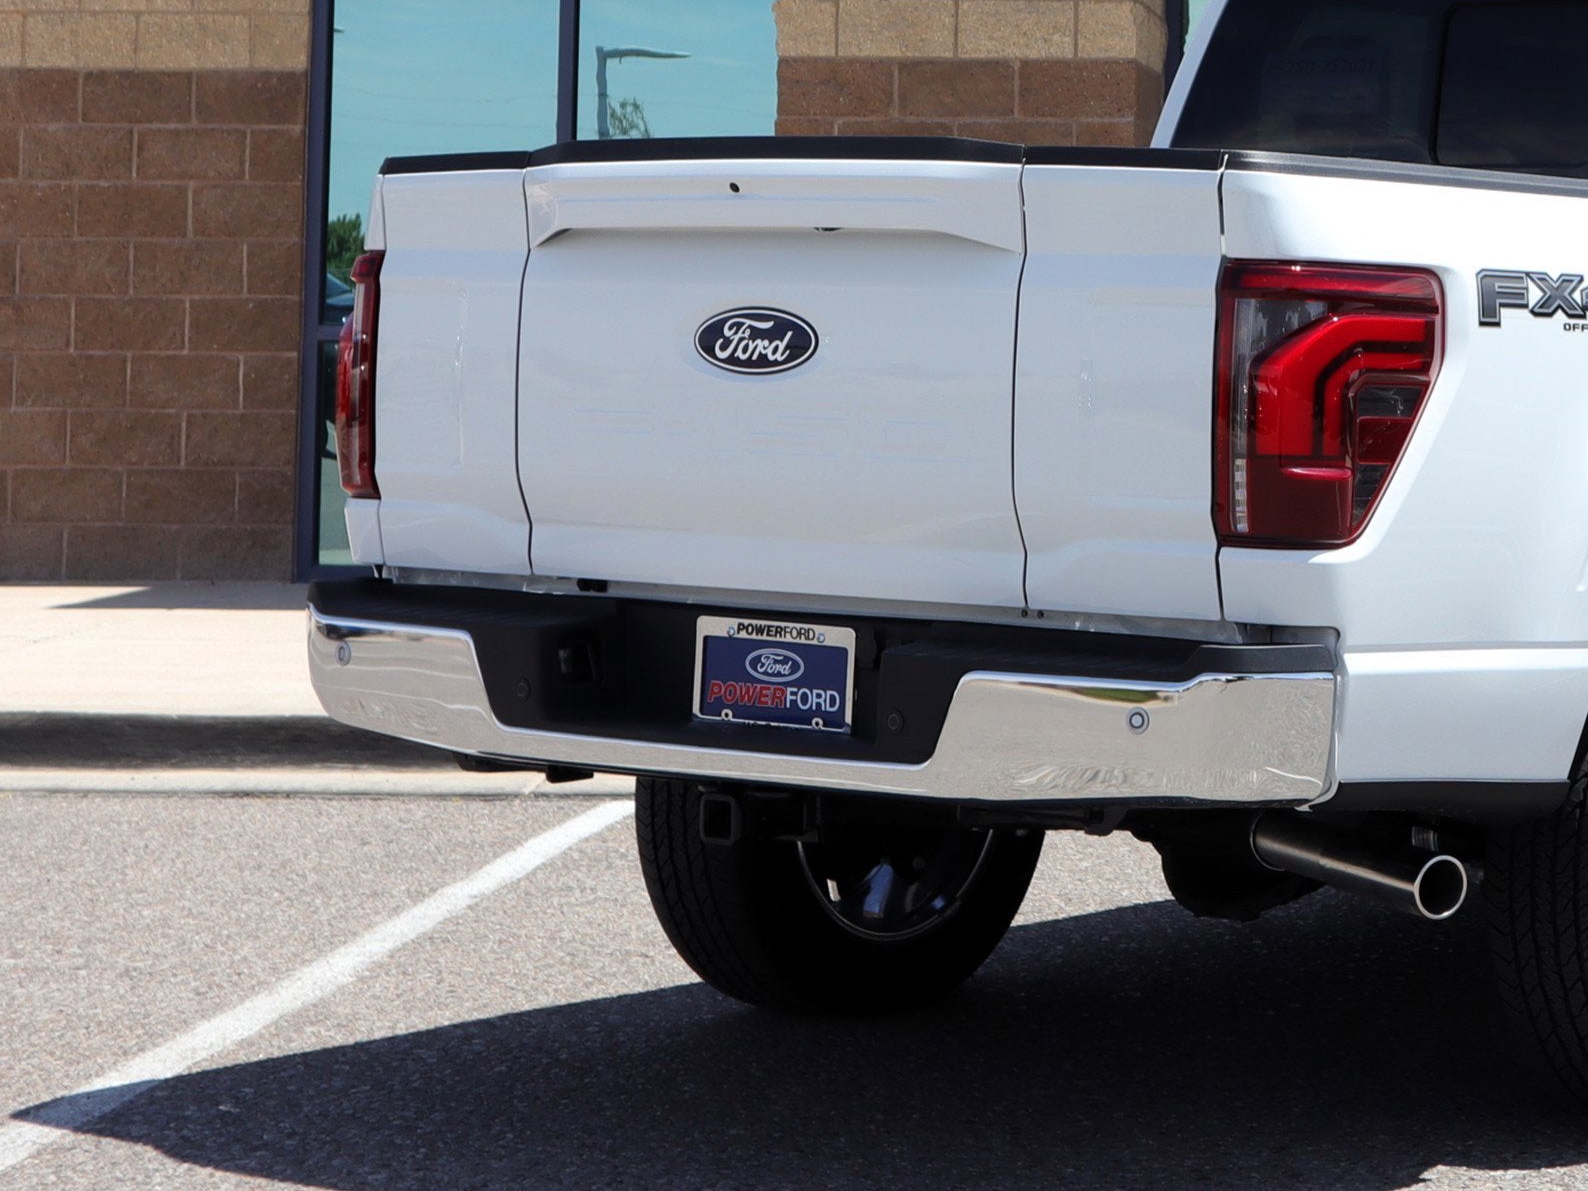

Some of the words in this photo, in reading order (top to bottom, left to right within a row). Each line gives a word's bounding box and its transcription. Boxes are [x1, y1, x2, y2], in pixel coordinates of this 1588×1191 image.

[714, 317, 794, 362] Ford
[736, 621, 816, 642] POWERFORD
[756, 652, 793, 676] Ford
